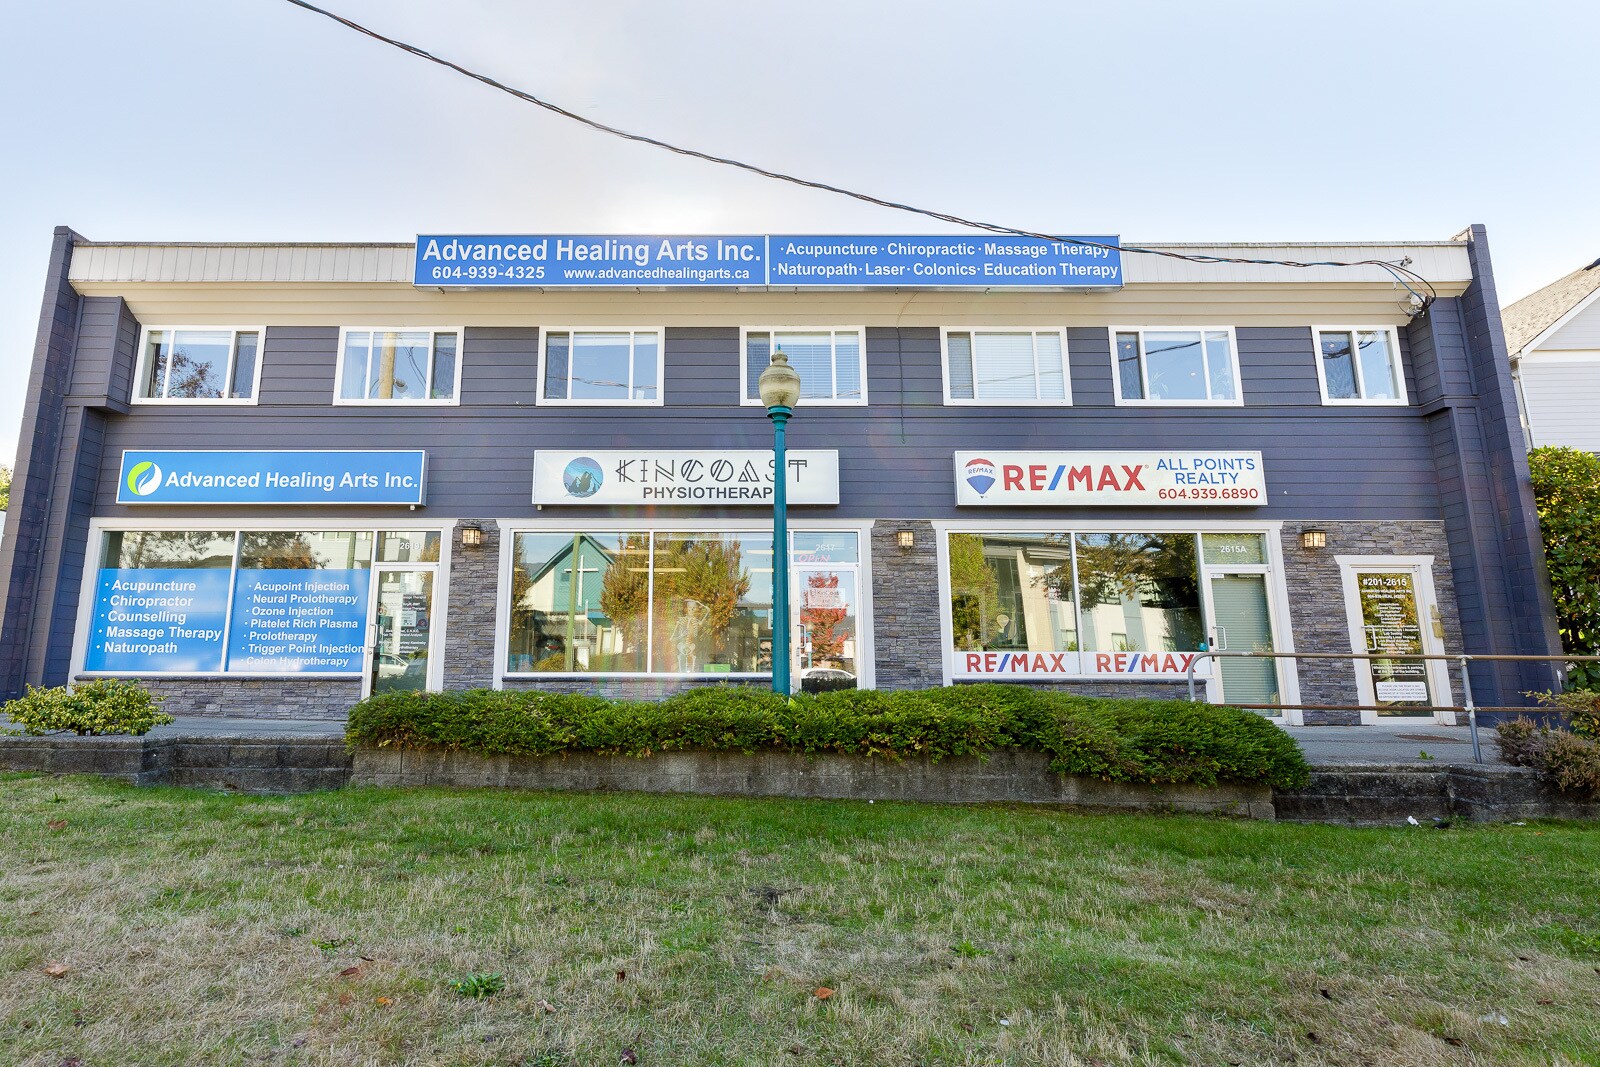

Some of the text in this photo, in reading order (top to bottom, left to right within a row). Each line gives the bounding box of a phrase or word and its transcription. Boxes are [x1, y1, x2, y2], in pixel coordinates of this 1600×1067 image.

[422, 239, 761, 267] Advanced Healing Arts Inc.
[785, 242, 1110, 258] Acupuncture Chiropractic Massage Therapy
[432, 266, 750, 282] 604-939-4325 www.advancedhealingarts.ca
[777, 262, 1119, 279] Naturopath Laser Colonics Education Therapy
[967, 466, 994, 476] RE/MAX
[1156, 458, 1255, 471] ALL POINTS
[164, 471, 418, 491] Advanced Healing Arts Inc.
[1002, 464, 1147, 492] RE/MAX
[1175, 472, 1239, 485] REALTY
[642, 486, 774, 499] PHYSIOTHERAP
[1158, 488, 1259, 500] 604.939.6890
[399, 542, 421, 550] 2619
[815, 544, 836, 552] 2617
[1220, 545, 1248, 553] 2615A
[111, 579, 197, 594] Acupuncture
[253, 581, 350, 593] Acupoint Injection
[1362, 578, 1407, 586] #201-2615
[109, 594, 194, 609] Chiropractor
[252, 593, 359, 606] Neural Prolotherapy
[107, 610, 187, 625] Counselling
[251, 606, 334, 617] Ozone Injection
[250, 618, 359, 629] Platelet Rich Plasma
[105, 625, 222, 641] Massage Therapy
[249, 631, 318, 643] Prolotherapy
[103, 641, 178, 656] Naturopath
[248, 643, 286, 656] Trigger
[288, 643, 317, 654] Point
[319, 643, 365, 656] Injection
[246, 656, 350, 668] Colon Hydrotherapy
[966, 653, 1067, 673] RE/MAX
[1096, 653, 1197, 673] RE/MAX
